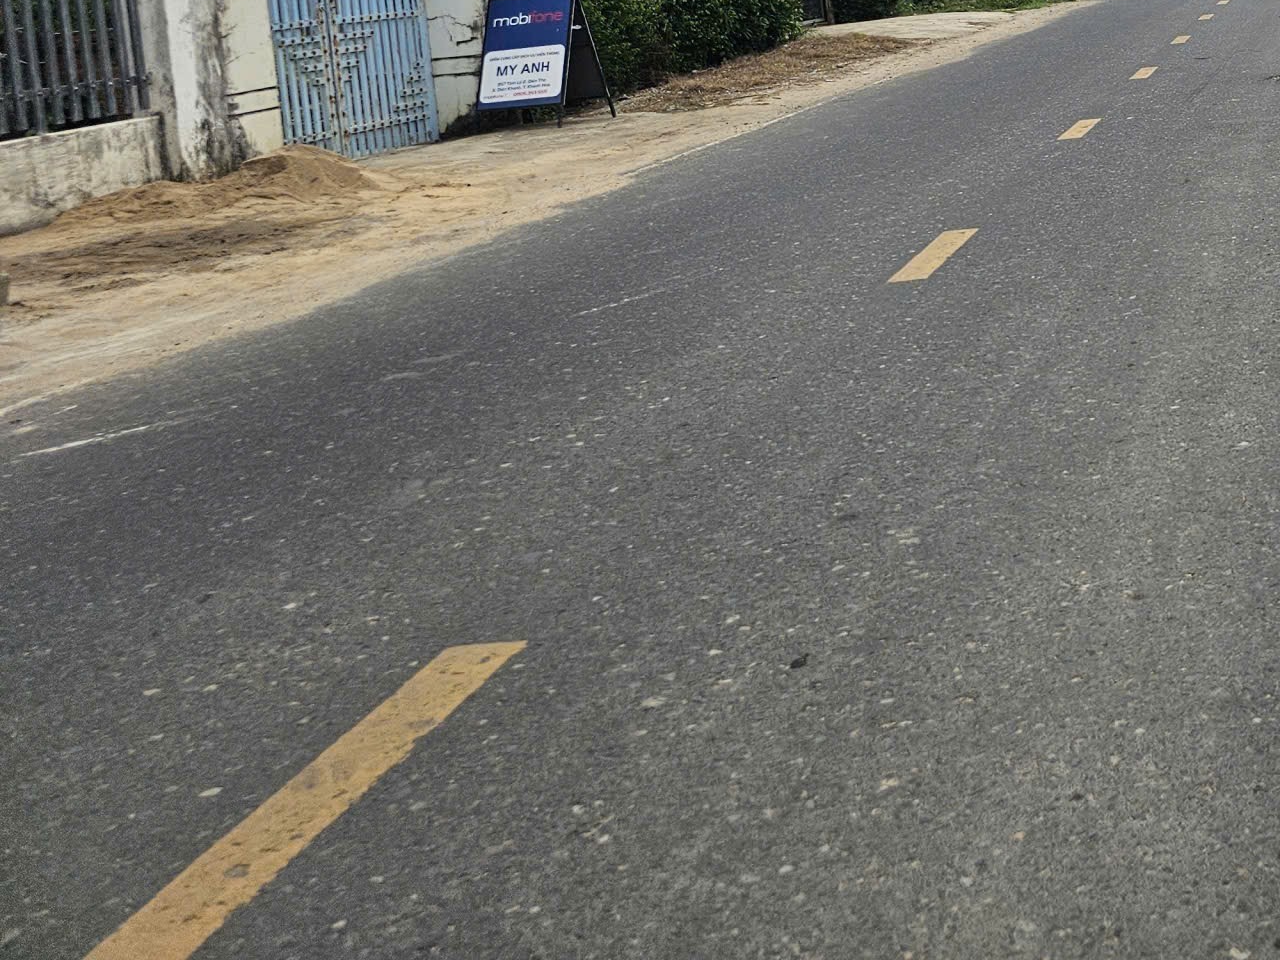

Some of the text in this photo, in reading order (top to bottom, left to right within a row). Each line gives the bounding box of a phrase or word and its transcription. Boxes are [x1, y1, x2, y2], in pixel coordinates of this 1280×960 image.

[493, 11, 564, 28] mobifone
[496, 61, 550, 77] MY ANH
